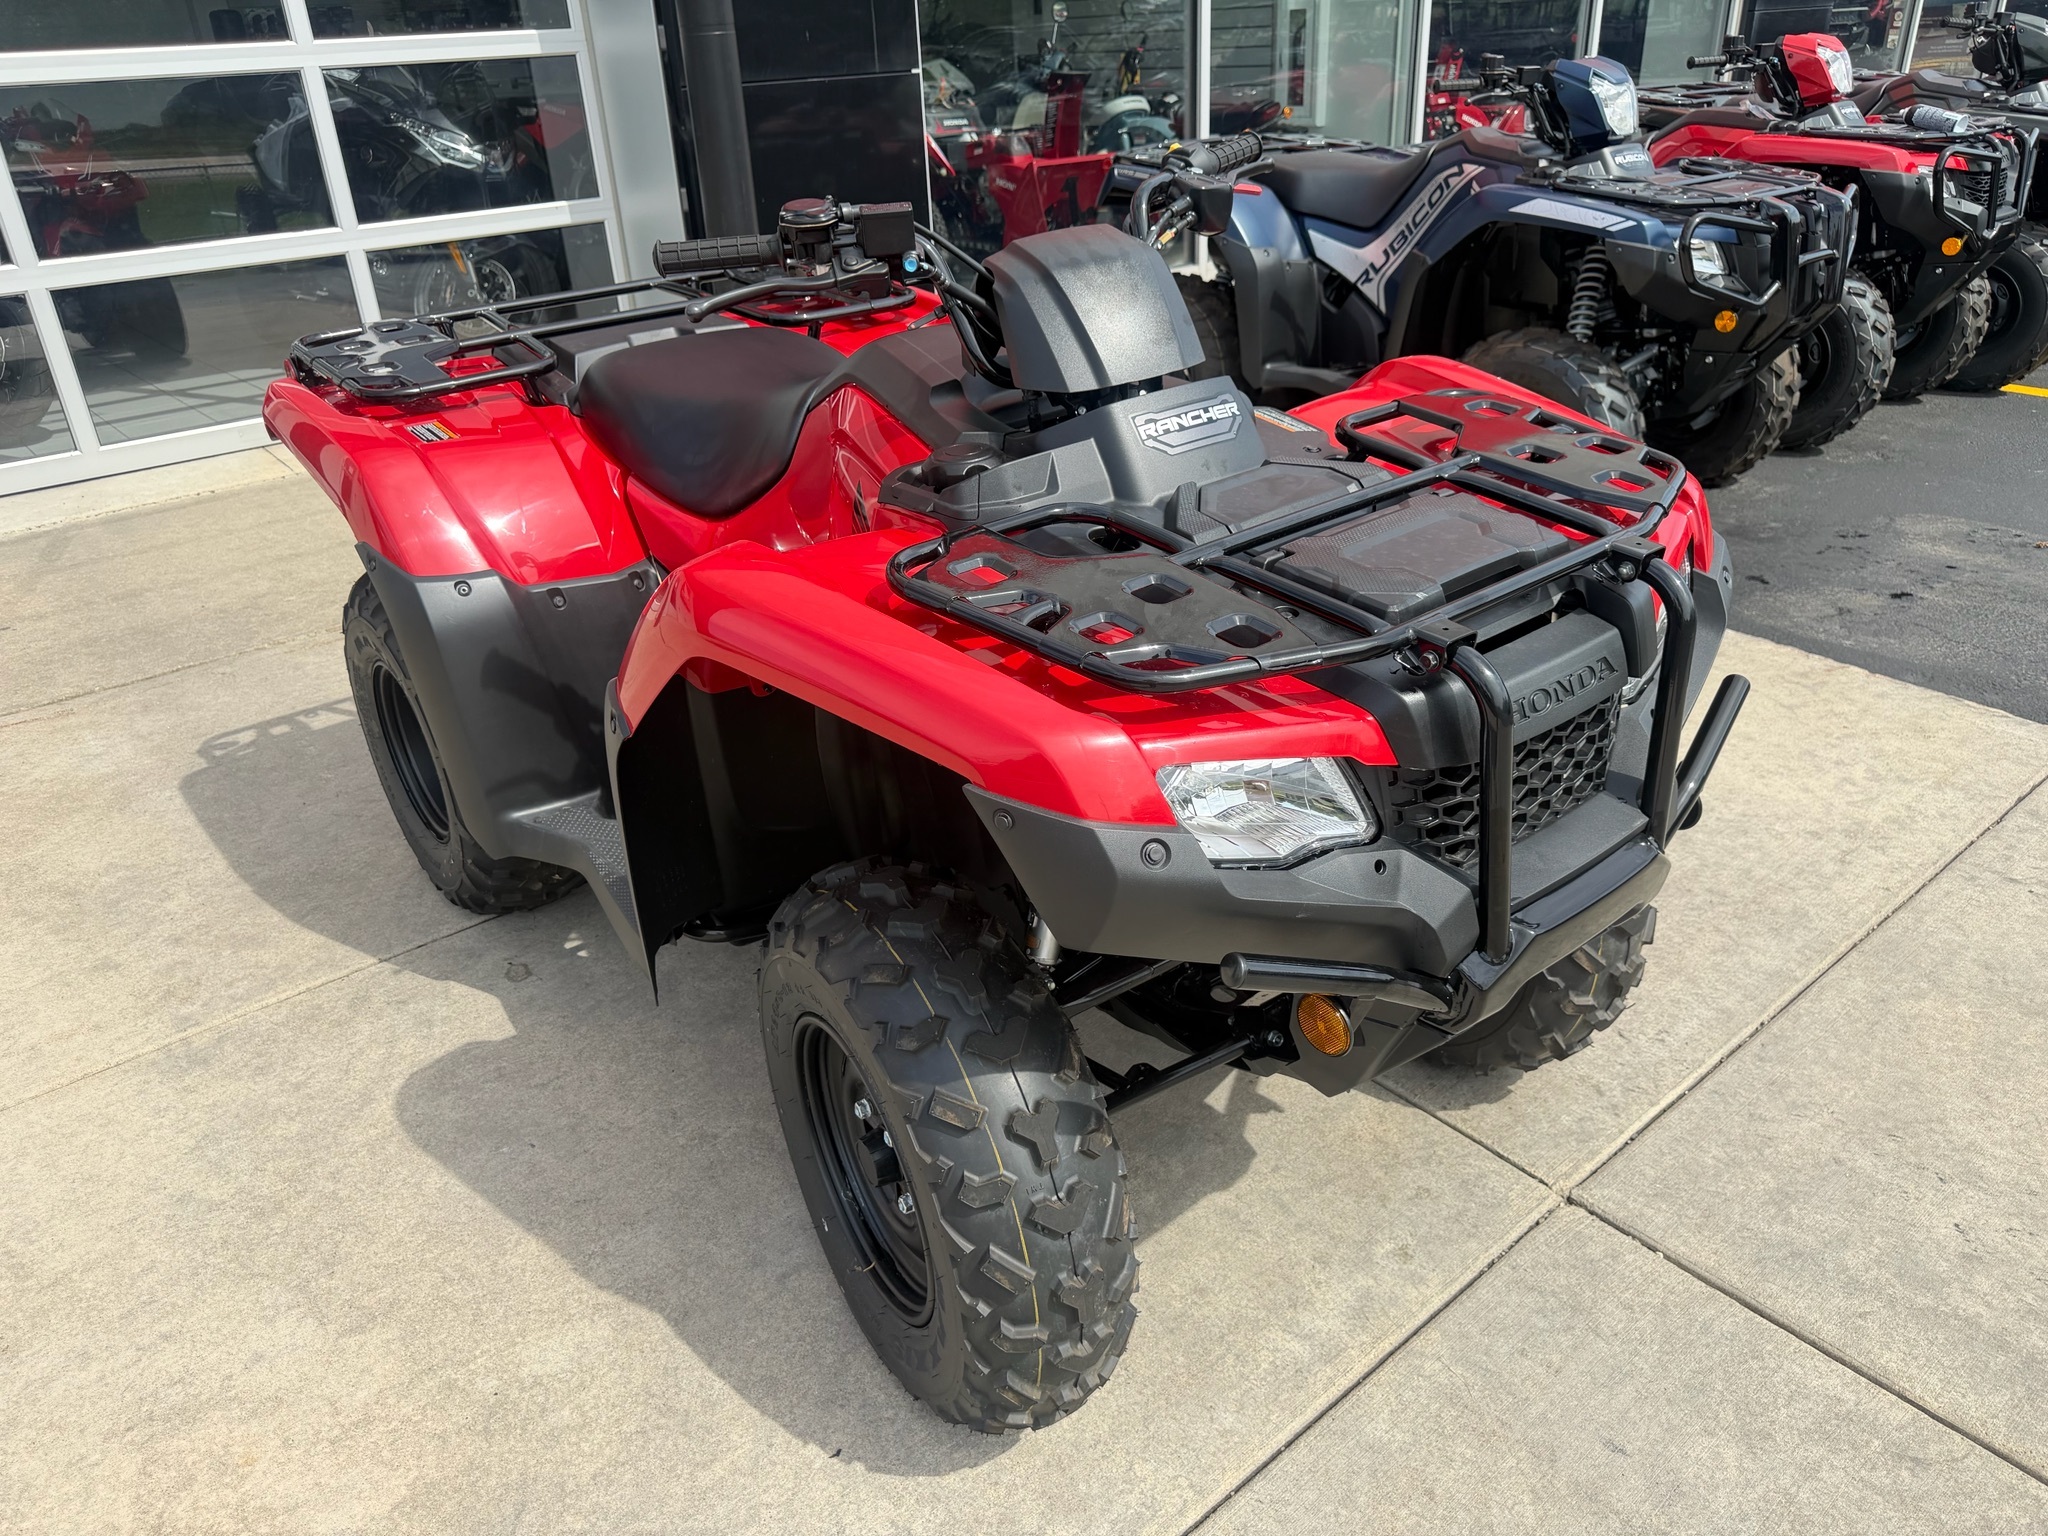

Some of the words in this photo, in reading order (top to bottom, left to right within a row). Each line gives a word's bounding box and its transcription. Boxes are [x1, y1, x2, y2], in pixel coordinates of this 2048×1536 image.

[1614, 152, 1650, 165] RUBICON
[1353, 163, 1465, 288] RUBICON
[1137, 401, 1241, 440] RANCHER
